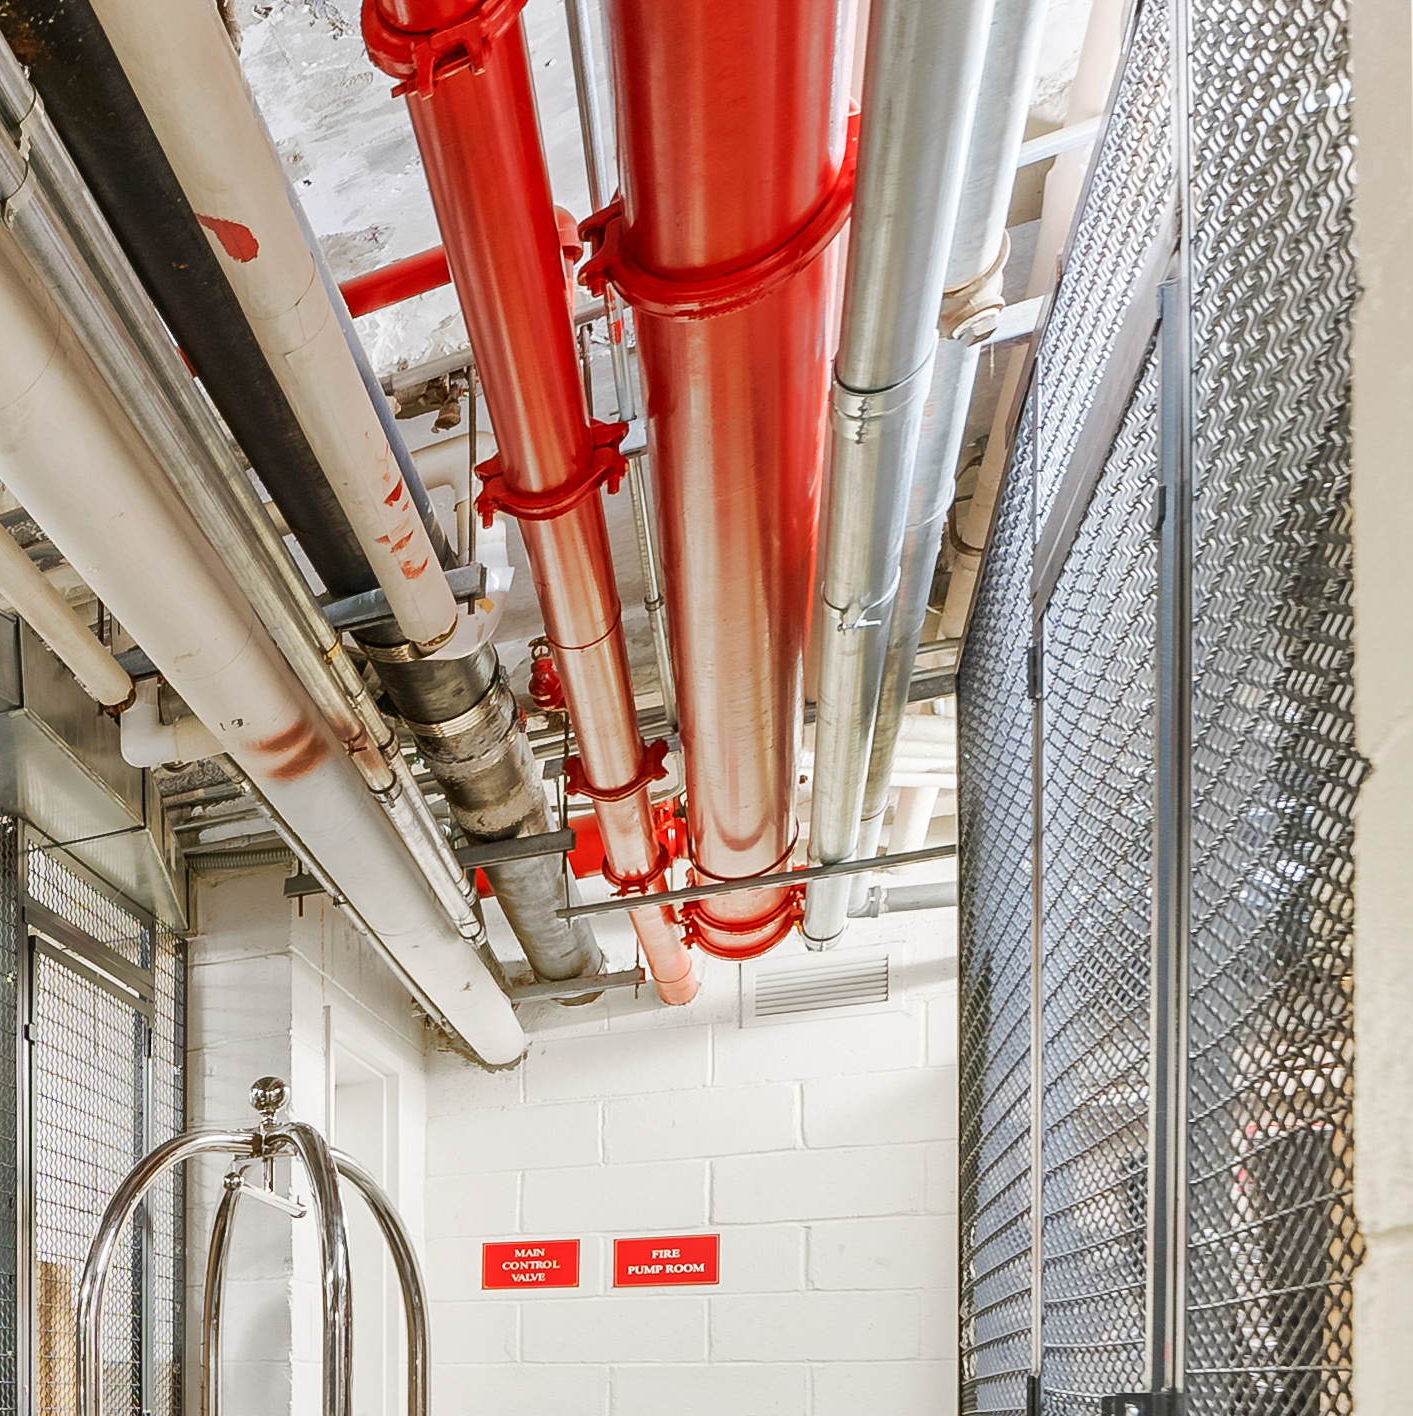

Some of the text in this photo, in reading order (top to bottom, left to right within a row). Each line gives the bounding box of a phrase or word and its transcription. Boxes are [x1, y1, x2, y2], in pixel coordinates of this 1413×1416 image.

[514, 1247, 545, 1259] MAIN
[651, 1248, 681, 1260] FIRE
[501, 1259, 560, 1271] CONTROL
[627, 1262, 705, 1276] PUMP ROOM
[511, 1271, 547, 1283] VALVE
